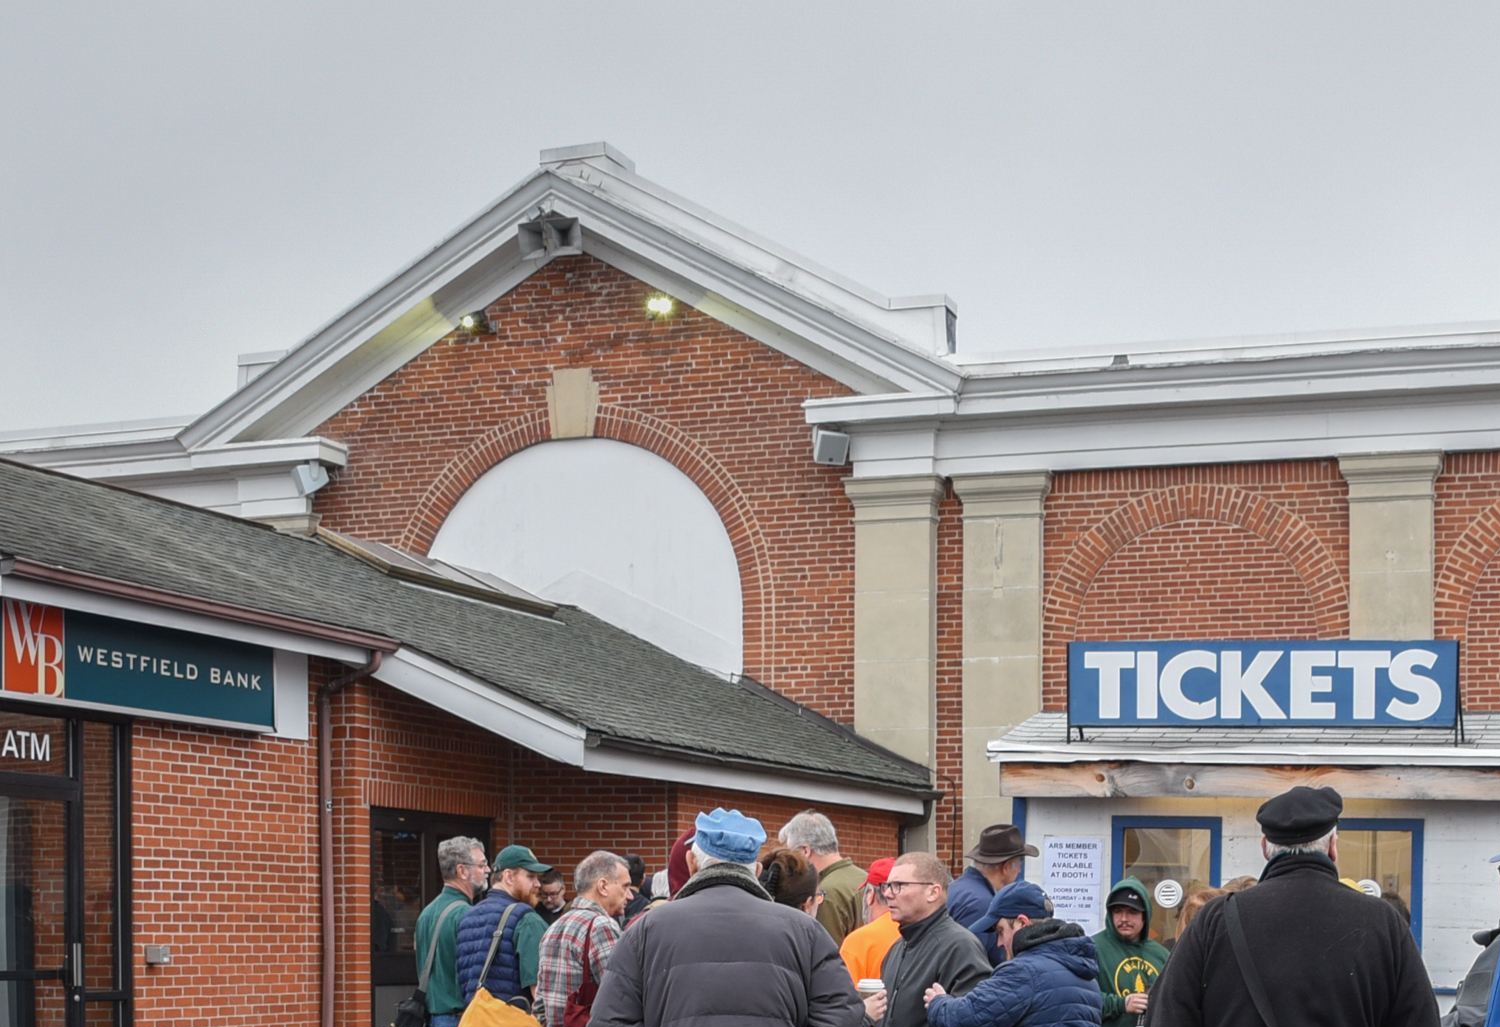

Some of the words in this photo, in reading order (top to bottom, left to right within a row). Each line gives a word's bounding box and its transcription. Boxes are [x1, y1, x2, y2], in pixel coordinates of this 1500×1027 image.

[77, 645, 199, 681] WESTFIELD
[209, 667, 262, 692] BANK
[1083, 648, 1442, 722] TICKETS
[1, 728, 51, 763] ATM
[1048, 842, 1064, 850] ARS
[1065, 842, 1098, 850] MEMBER
[1057, 852, 1088, 860] TICKETS
[1051, 862, 1093, 870] AVAILABLE
[1050, 871, 1060, 879] AT
[1061, 871, 1088, 879] BOOTH
